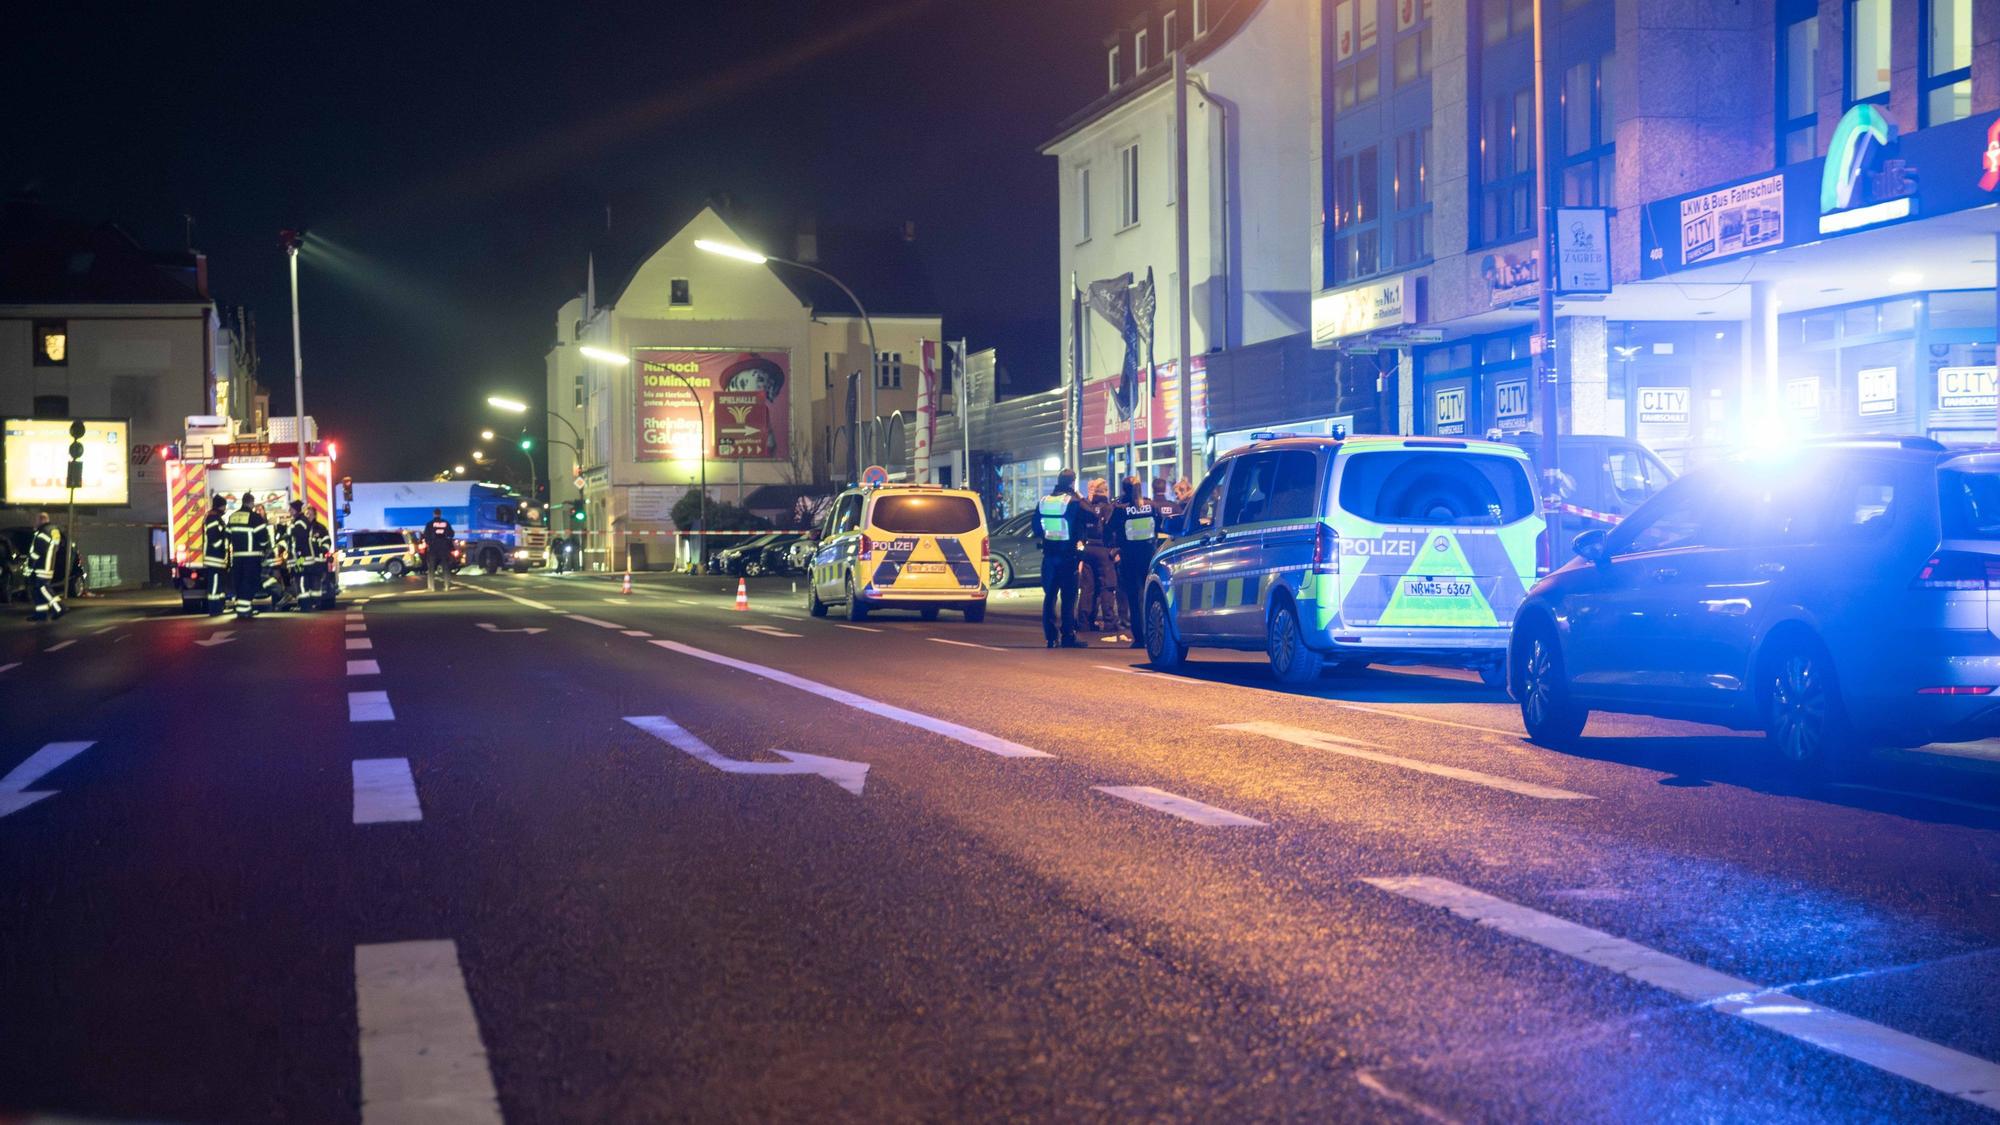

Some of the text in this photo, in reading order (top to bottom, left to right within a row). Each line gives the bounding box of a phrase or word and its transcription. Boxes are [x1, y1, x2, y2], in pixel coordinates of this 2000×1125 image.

[1683, 179, 1782, 216] LKW & Bus Fahrschule
[1686, 215, 1713, 247] CITY
[1564, 253, 1602, 263] ZAGREB
[667, 361, 699, 373] noch
[643, 375, 711, 387] 10 Minuten
[1946, 372, 1998, 393] CITY
[1439, 395, 1463, 420] CITY
[1499, 385, 1526, 414] CITY
[1643, 392, 1685, 410] CITY
[872, 541, 914, 551] POLIZEI
[1341, 539, 1416, 556] POLIZEI
[1410, 583, 1430, 594] NRW
